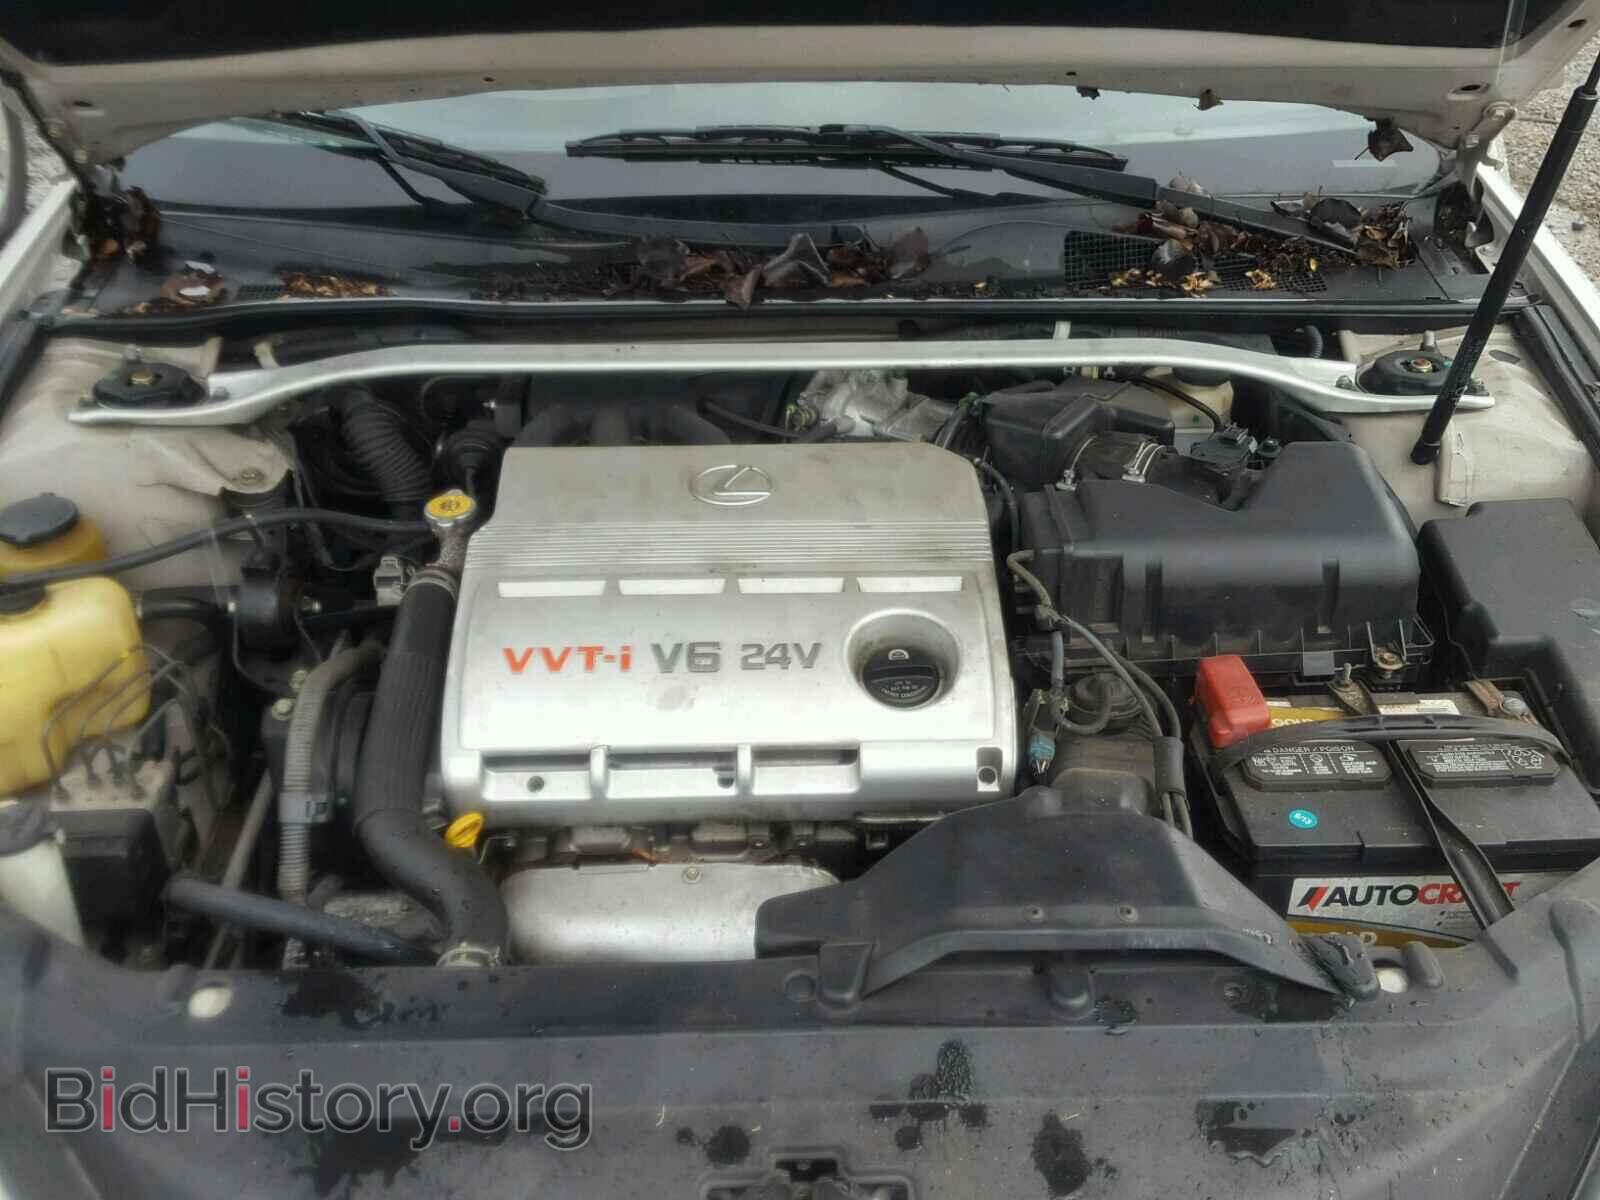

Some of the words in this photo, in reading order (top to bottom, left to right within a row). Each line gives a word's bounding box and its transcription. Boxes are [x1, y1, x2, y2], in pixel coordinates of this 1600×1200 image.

[502, 645, 632, 674] VVT-i
[651, 641, 721, 674] V6
[740, 641, 822, 671] 24V
[1321, 882, 1521, 908] AUTOCRT
